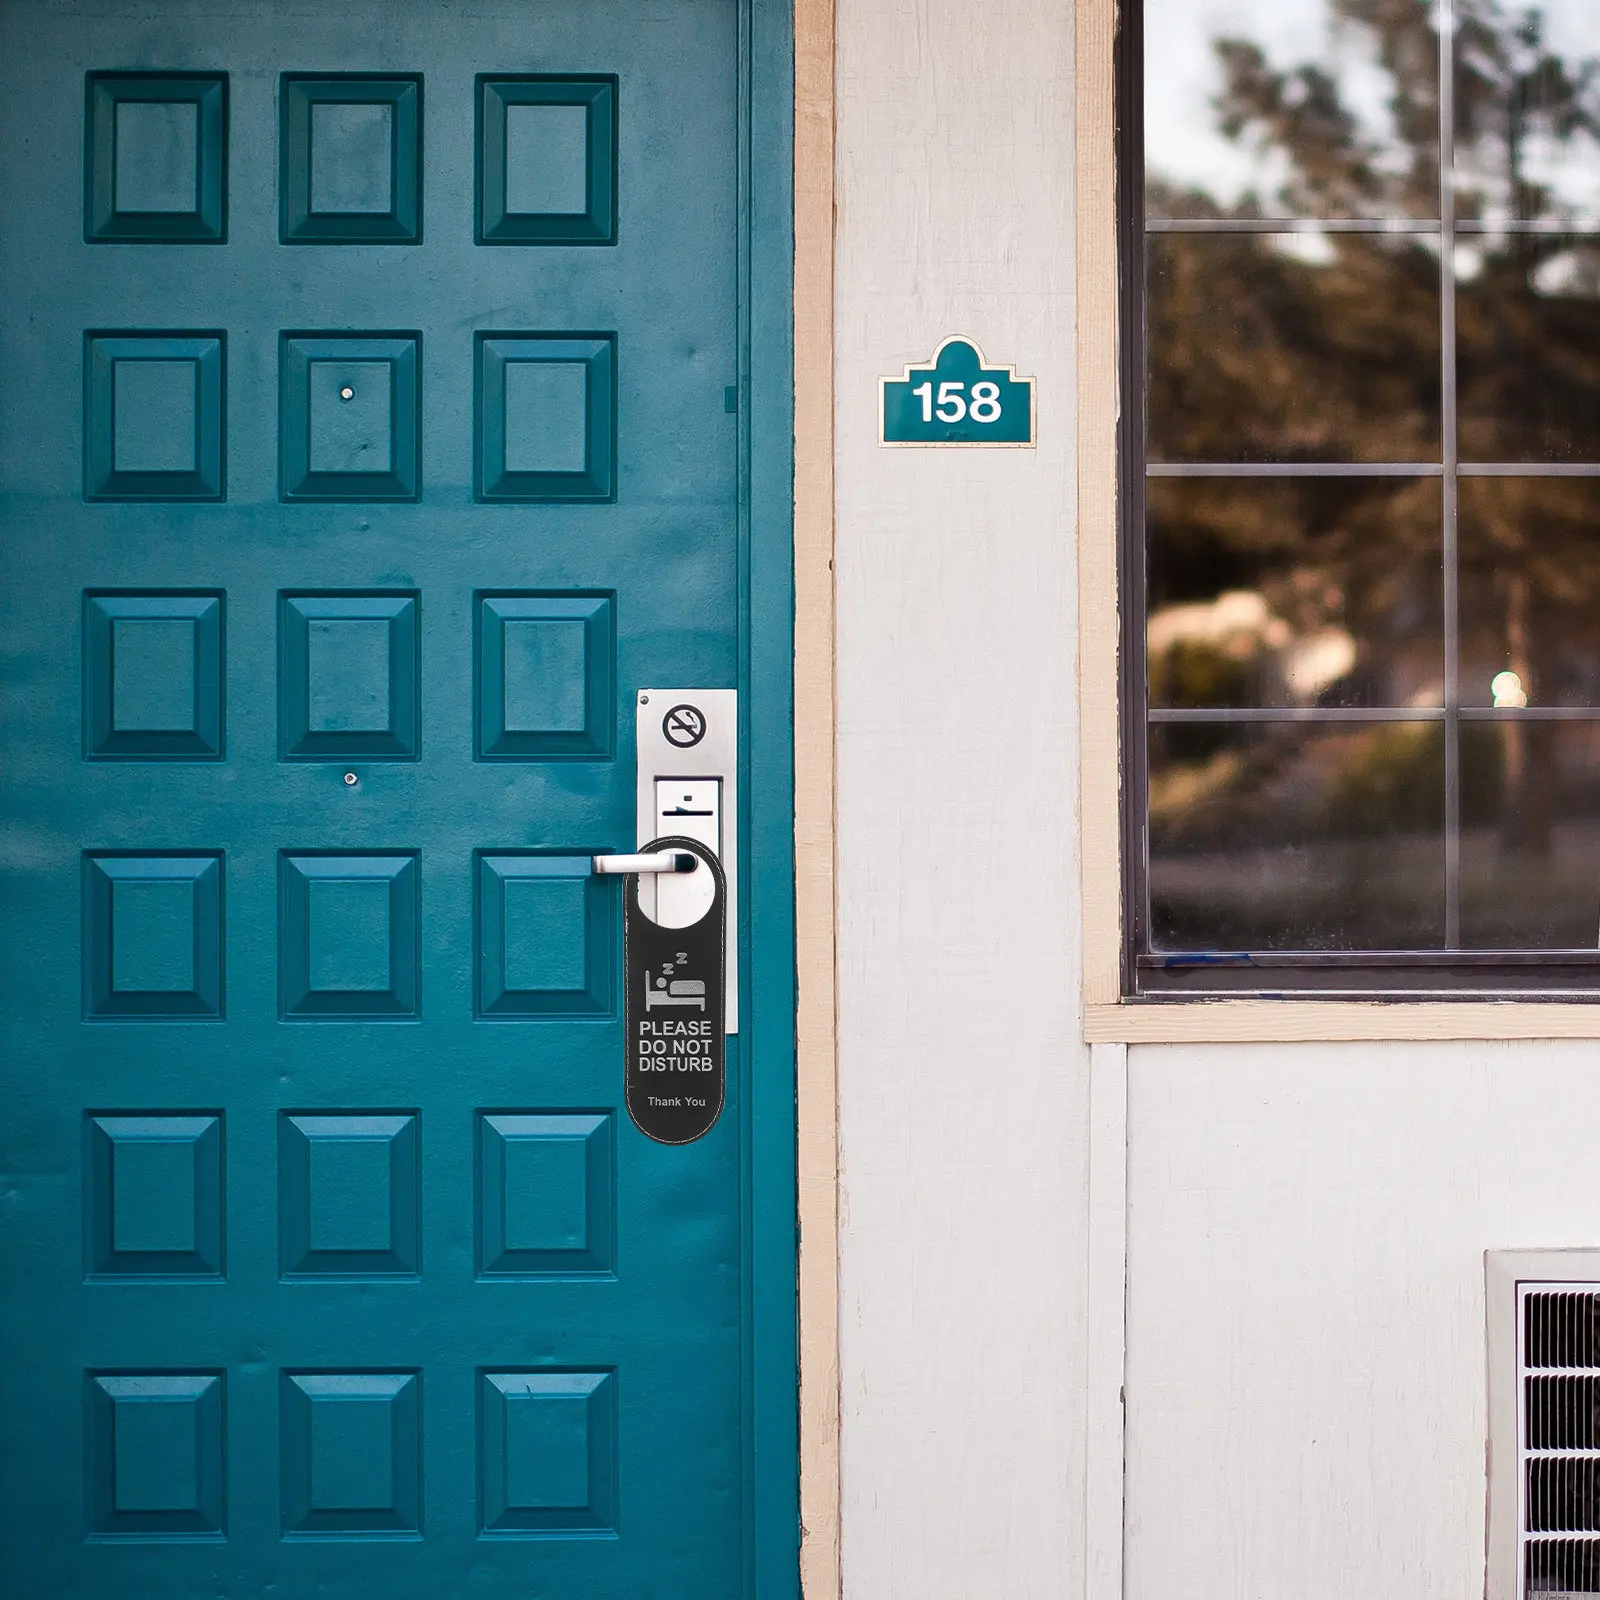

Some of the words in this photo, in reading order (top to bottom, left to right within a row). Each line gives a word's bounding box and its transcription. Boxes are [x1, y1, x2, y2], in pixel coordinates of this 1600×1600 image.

[912, 381, 1002, 423] 158
[639, 1021, 712, 1036] PLEASE
[639, 1040, 667, 1055] DO
[673, 1040, 713, 1055] NOT
[639, 1057, 713, 1072] DISTURB
[648, 1096, 682, 1107] Thank
[685, 1096, 706, 1107] You
